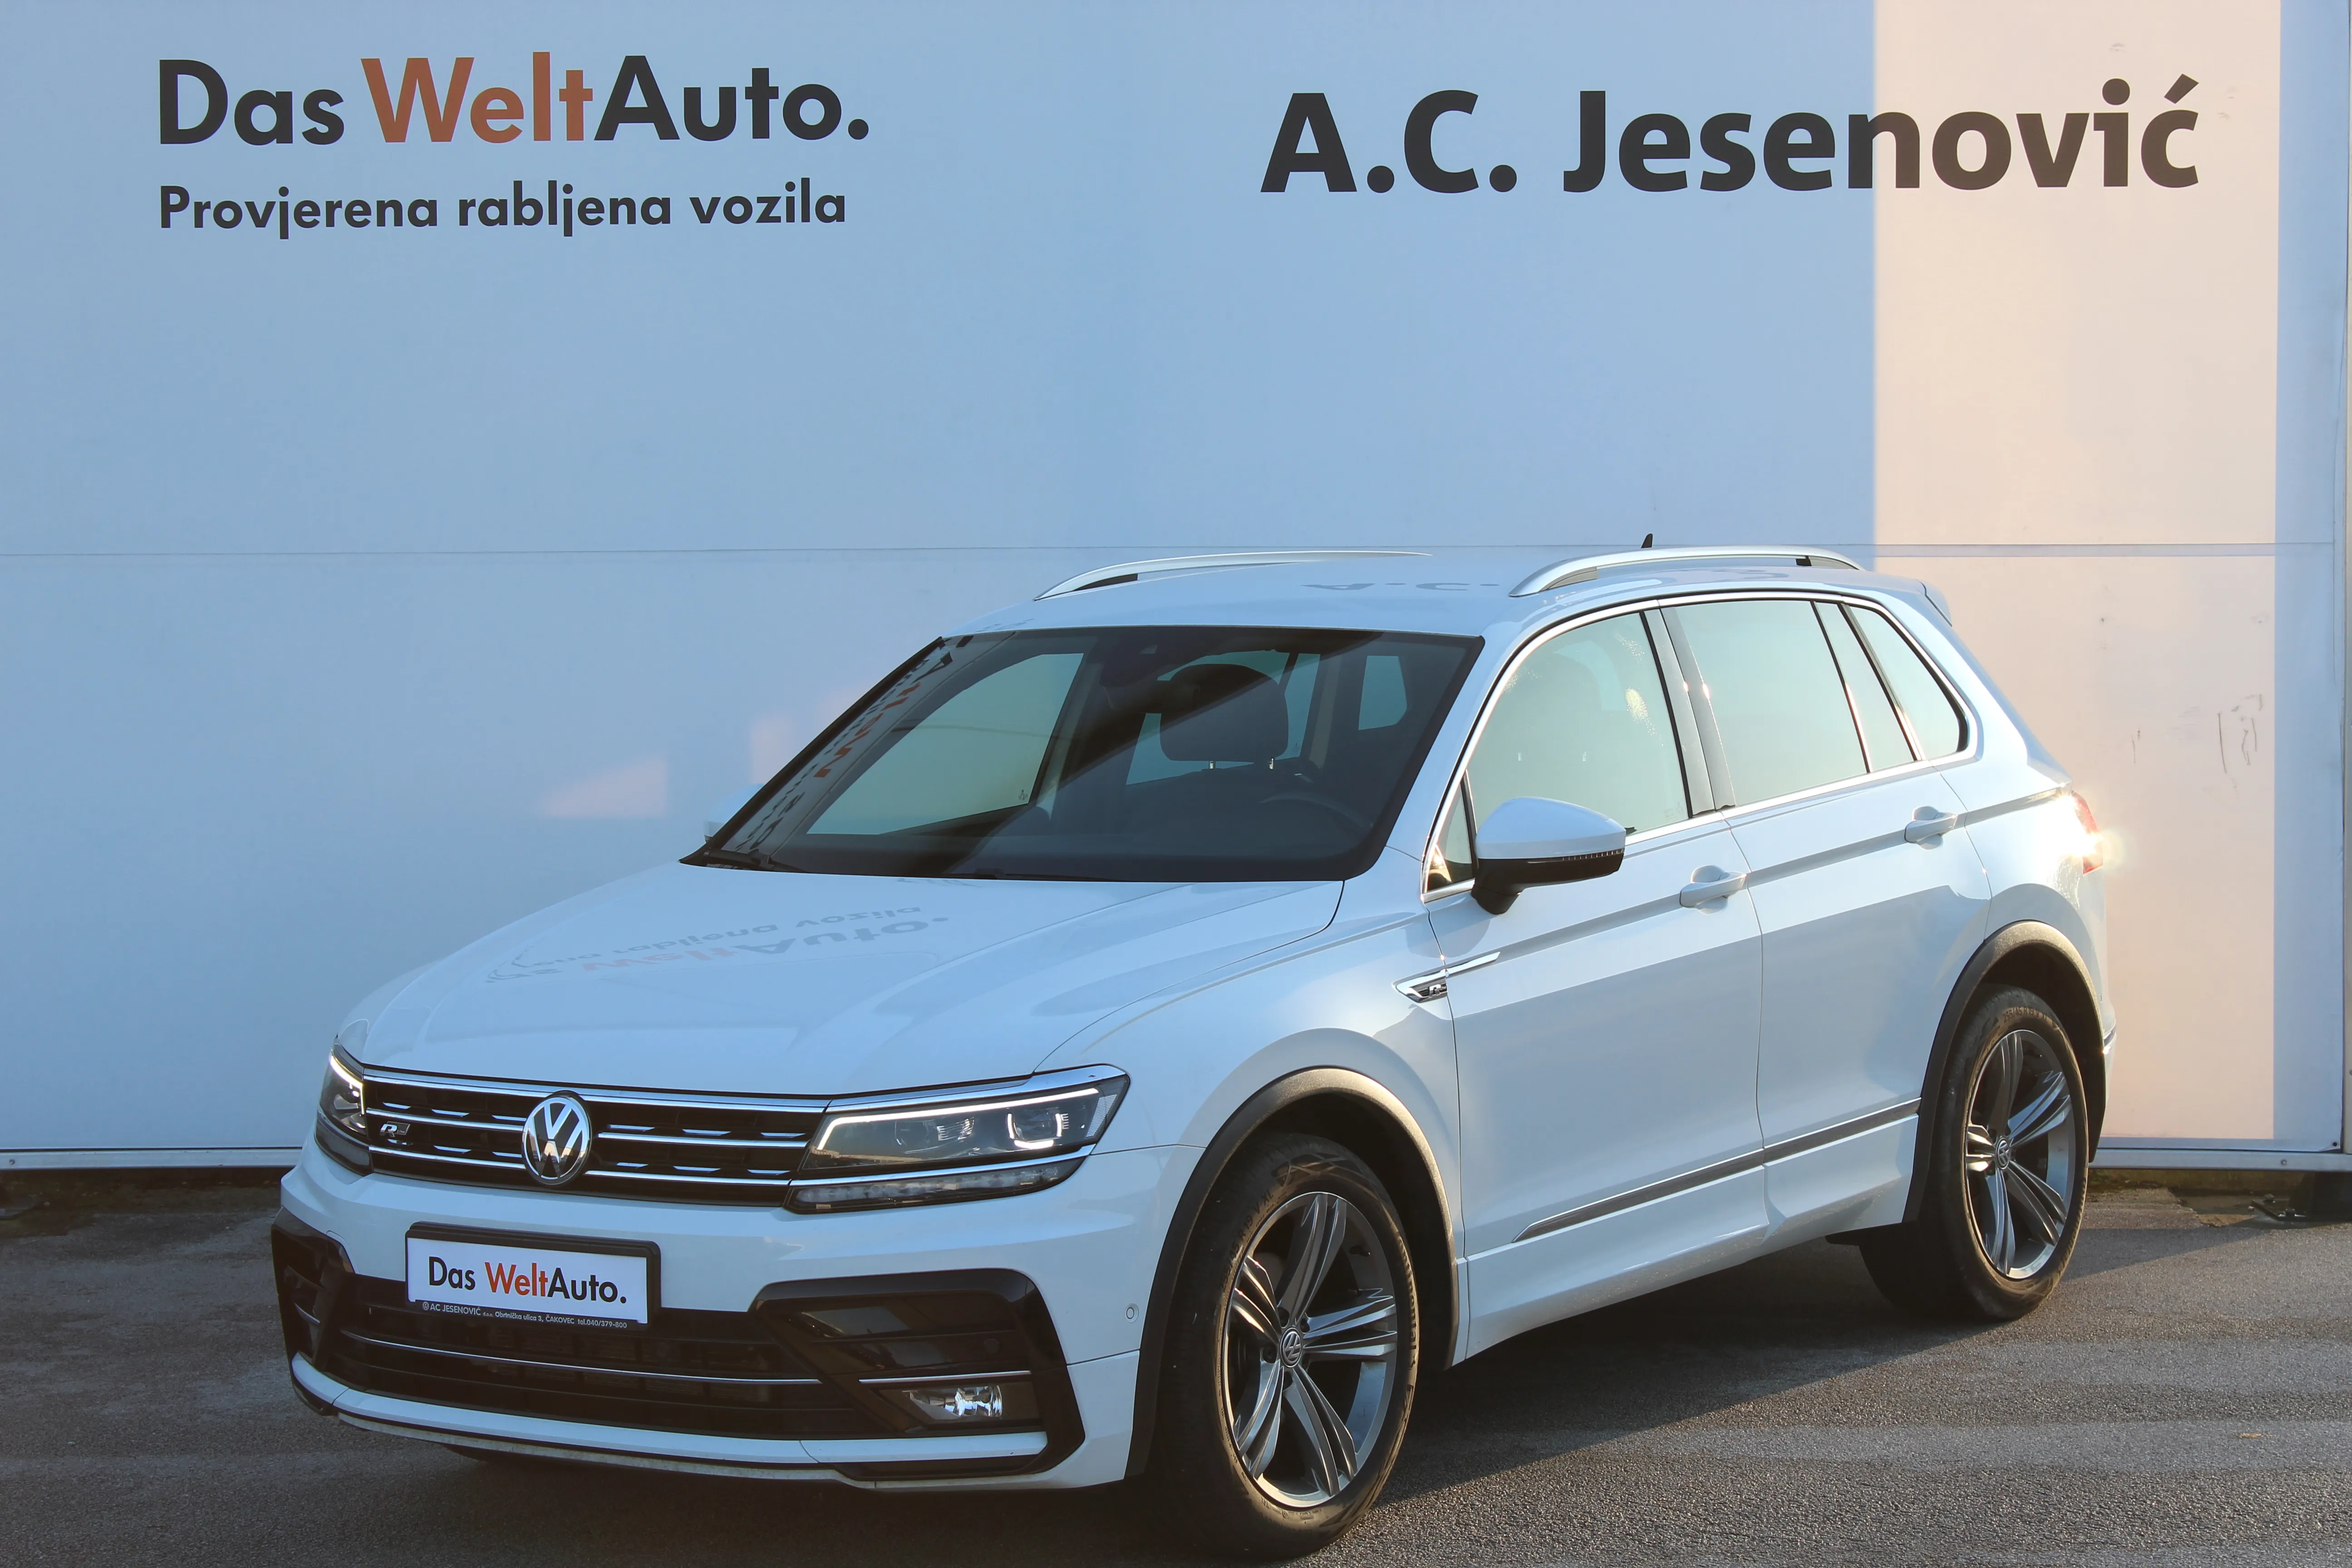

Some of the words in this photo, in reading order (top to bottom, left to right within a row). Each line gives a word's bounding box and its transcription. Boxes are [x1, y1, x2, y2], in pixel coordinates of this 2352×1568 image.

[159, 59, 344, 146] Das
[361, 52, 869, 143] WeltAuto.
[1260, 89, 1518, 193] A.C.
[1563, 73, 2199, 193] Jesenović
[160, 185, 437, 240] Provjerena
[458, 180, 671, 237] rabljena
[690, 177, 845, 224] vozila
[428, 1256, 476, 1291] Das
[484, 1262, 627, 1304] WeltAuto.
[430, 1303, 441, 1311] AC
[442, 1305, 481, 1316] JESENOVIĆ
[495, 1311, 522, 1320] Obrtnička
[545, 1314, 575, 1324] ČAKOVEC
[578, 1318, 627, 1328] tel.040/379-800
